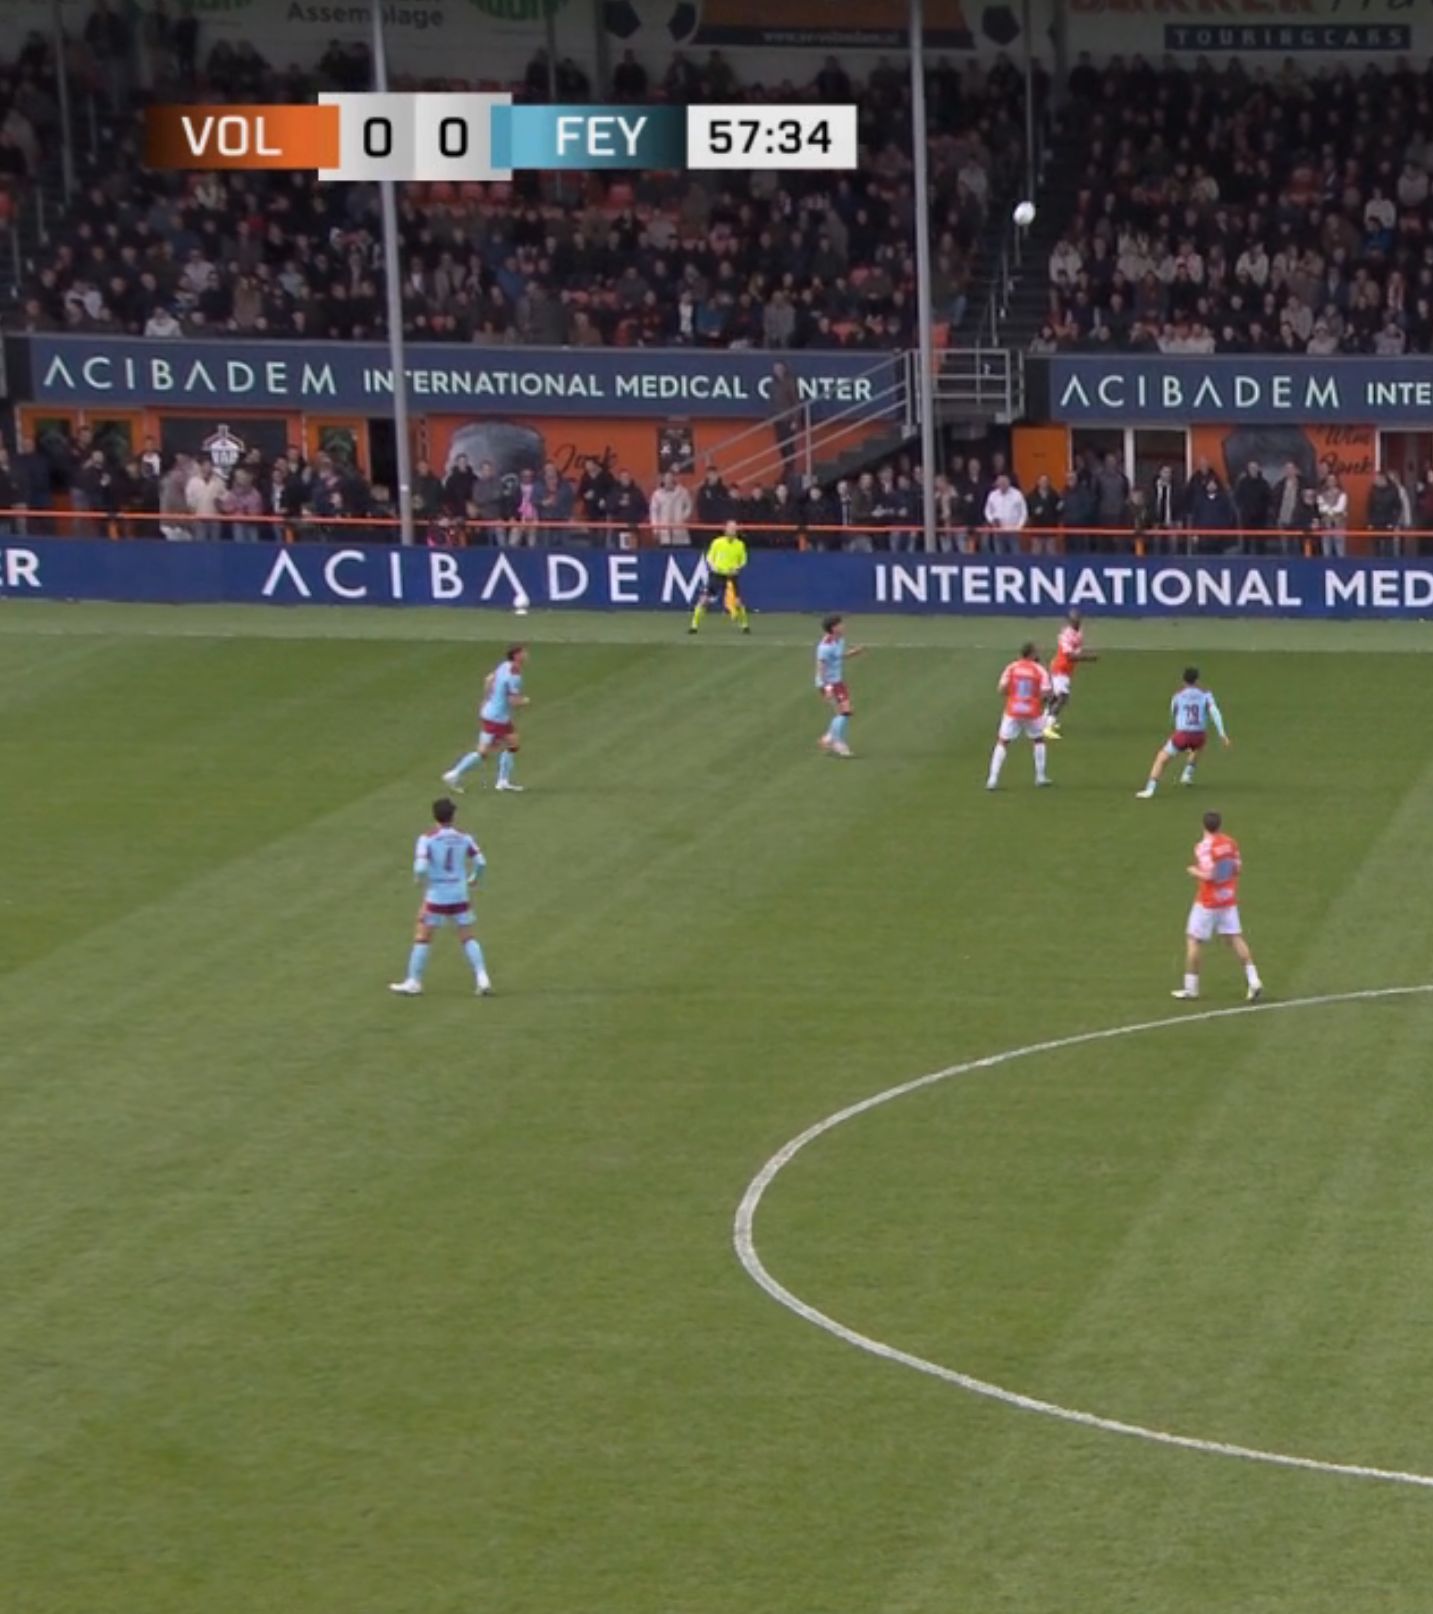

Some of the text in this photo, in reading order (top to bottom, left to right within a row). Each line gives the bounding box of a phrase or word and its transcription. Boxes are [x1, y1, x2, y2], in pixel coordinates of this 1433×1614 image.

[1171, 28, 1402, 46] TOURINGCARS
[615, 373, 749, 400] MEDICAL
[757, 376, 872, 401] CNTER
[875, 564, 1301, 608] INTERNATIONAL
